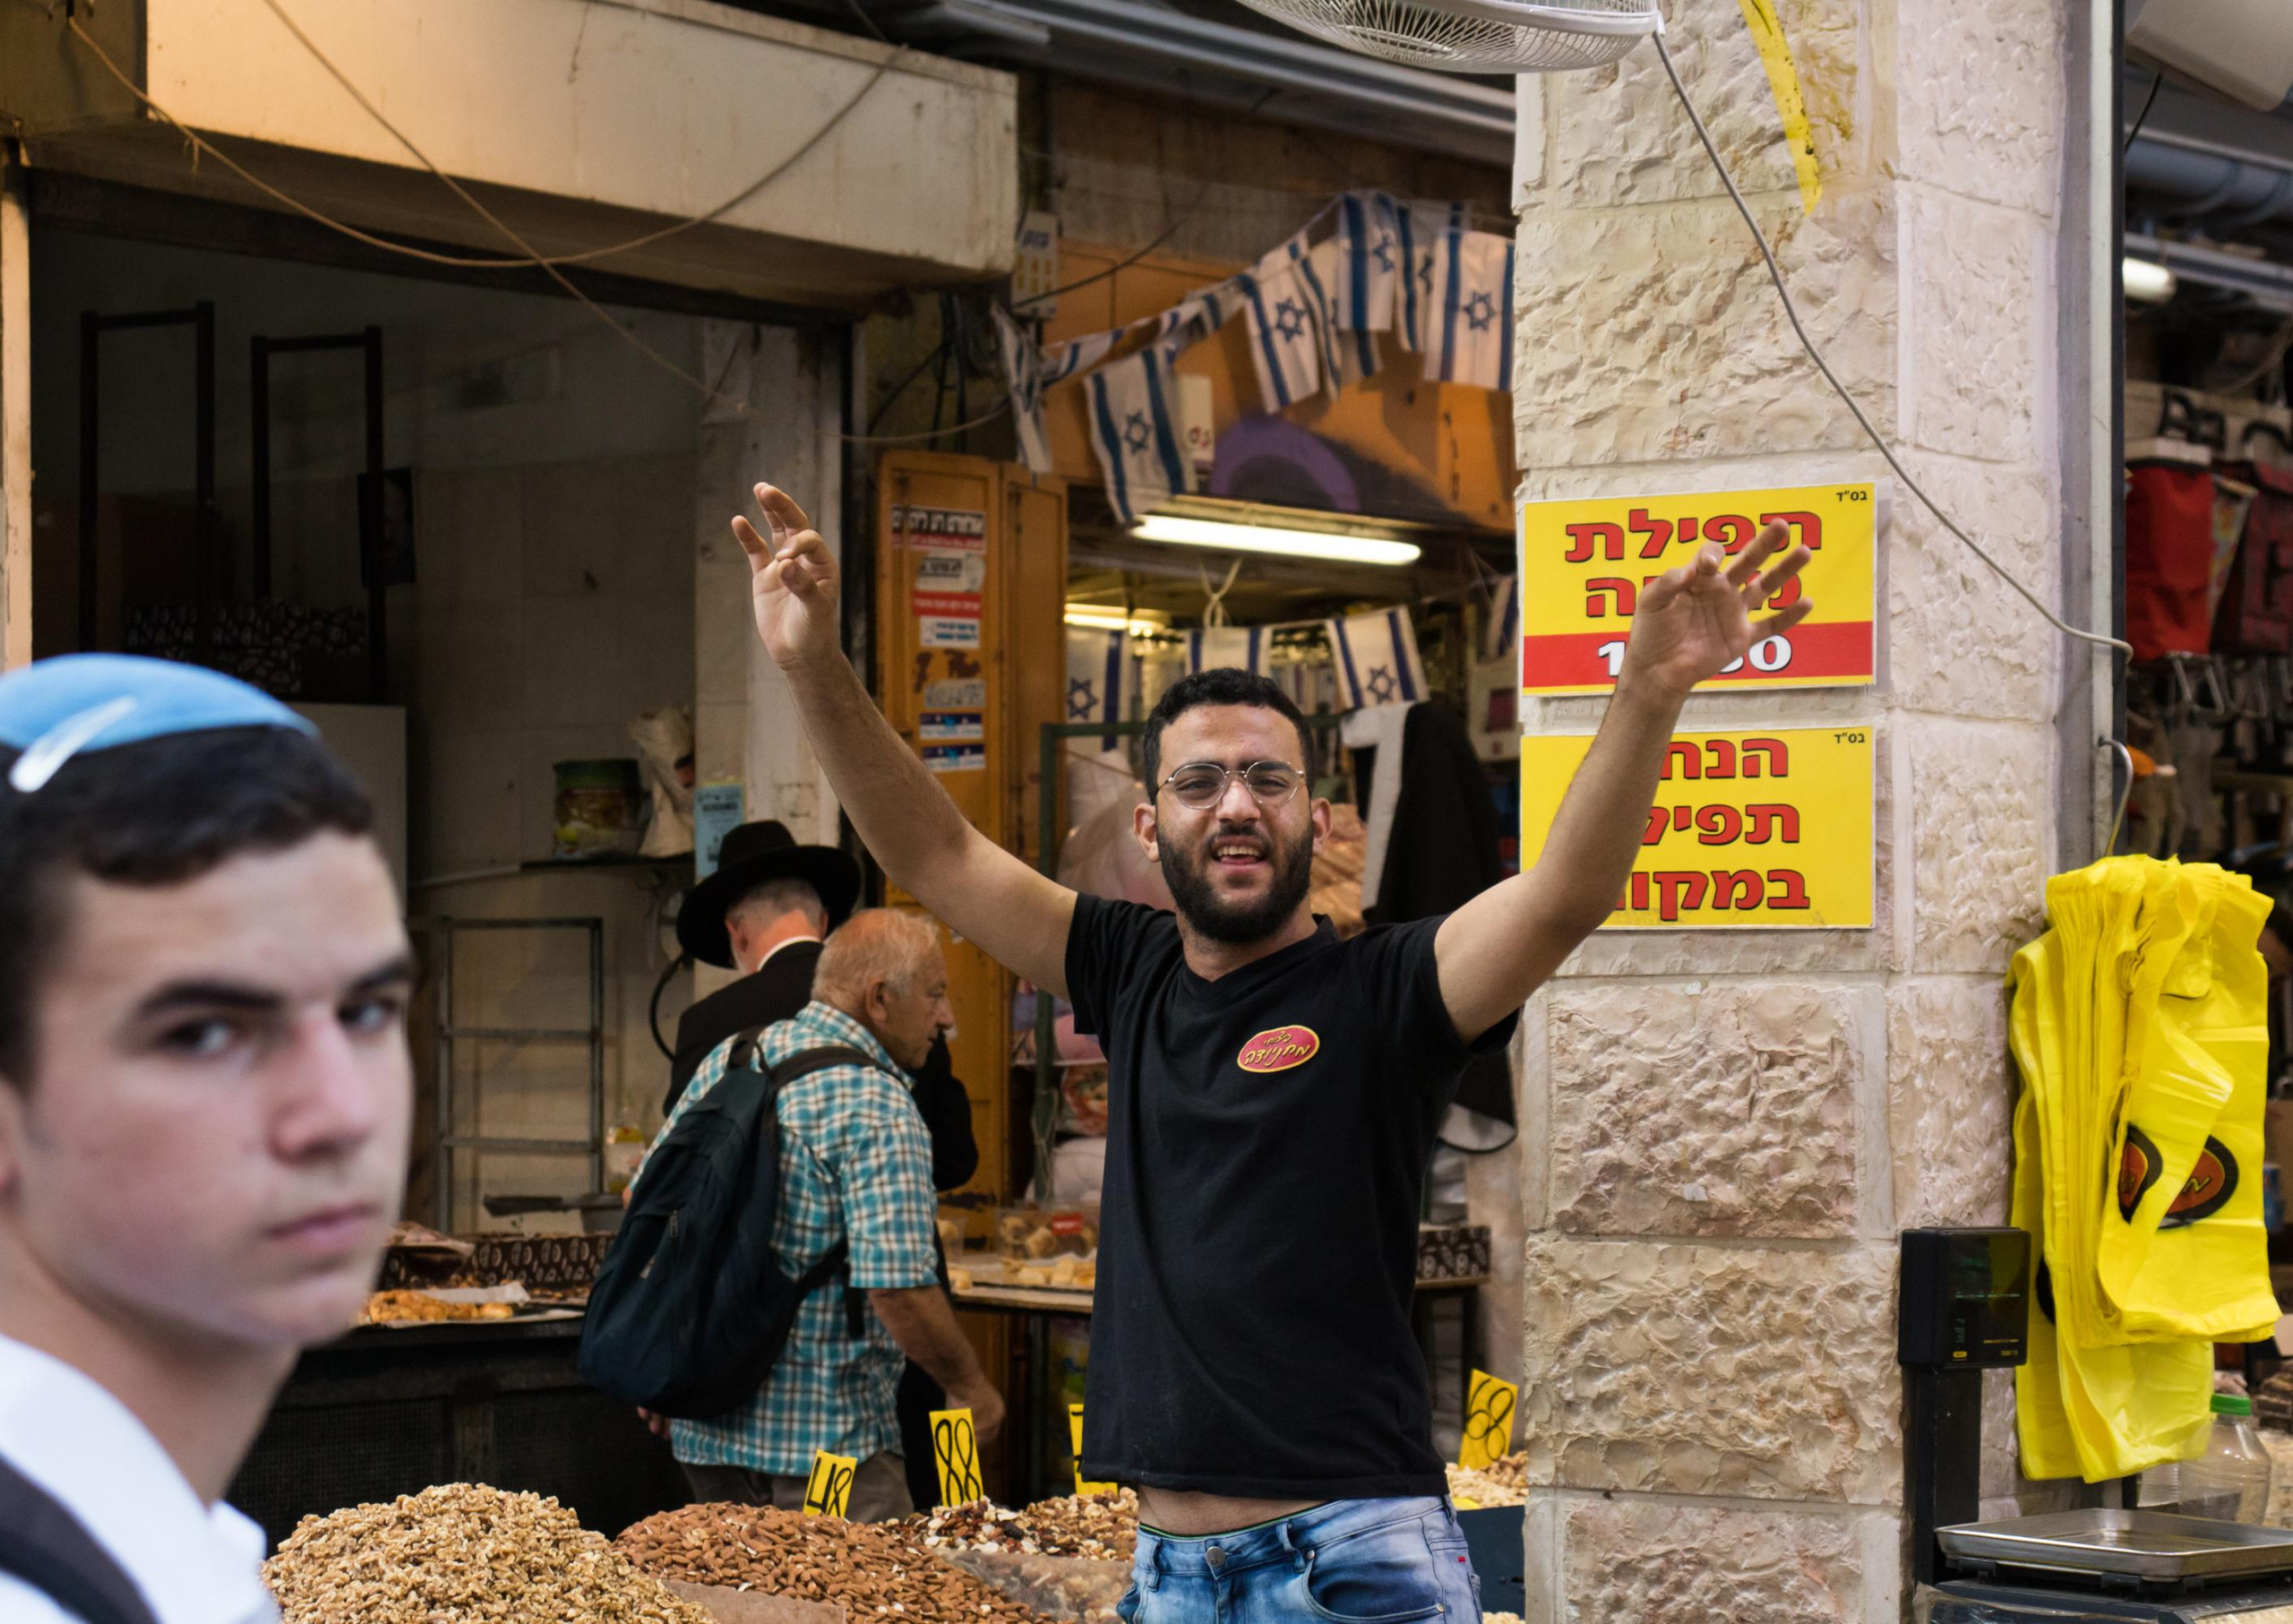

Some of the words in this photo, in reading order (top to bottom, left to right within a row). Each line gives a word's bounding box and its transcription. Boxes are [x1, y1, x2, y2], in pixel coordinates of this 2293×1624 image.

[1565, 509, 1822, 563] תפילת
[1660, 738, 1789, 780] הנח
[1642, 803, 1800, 846] תפיל
[1616, 869, 1810, 921] במקו
[1466, 1378, 1515, 1461] 68
[806, 1456, 853, 1517] 48
[934, 1418, 981, 1507] 88
